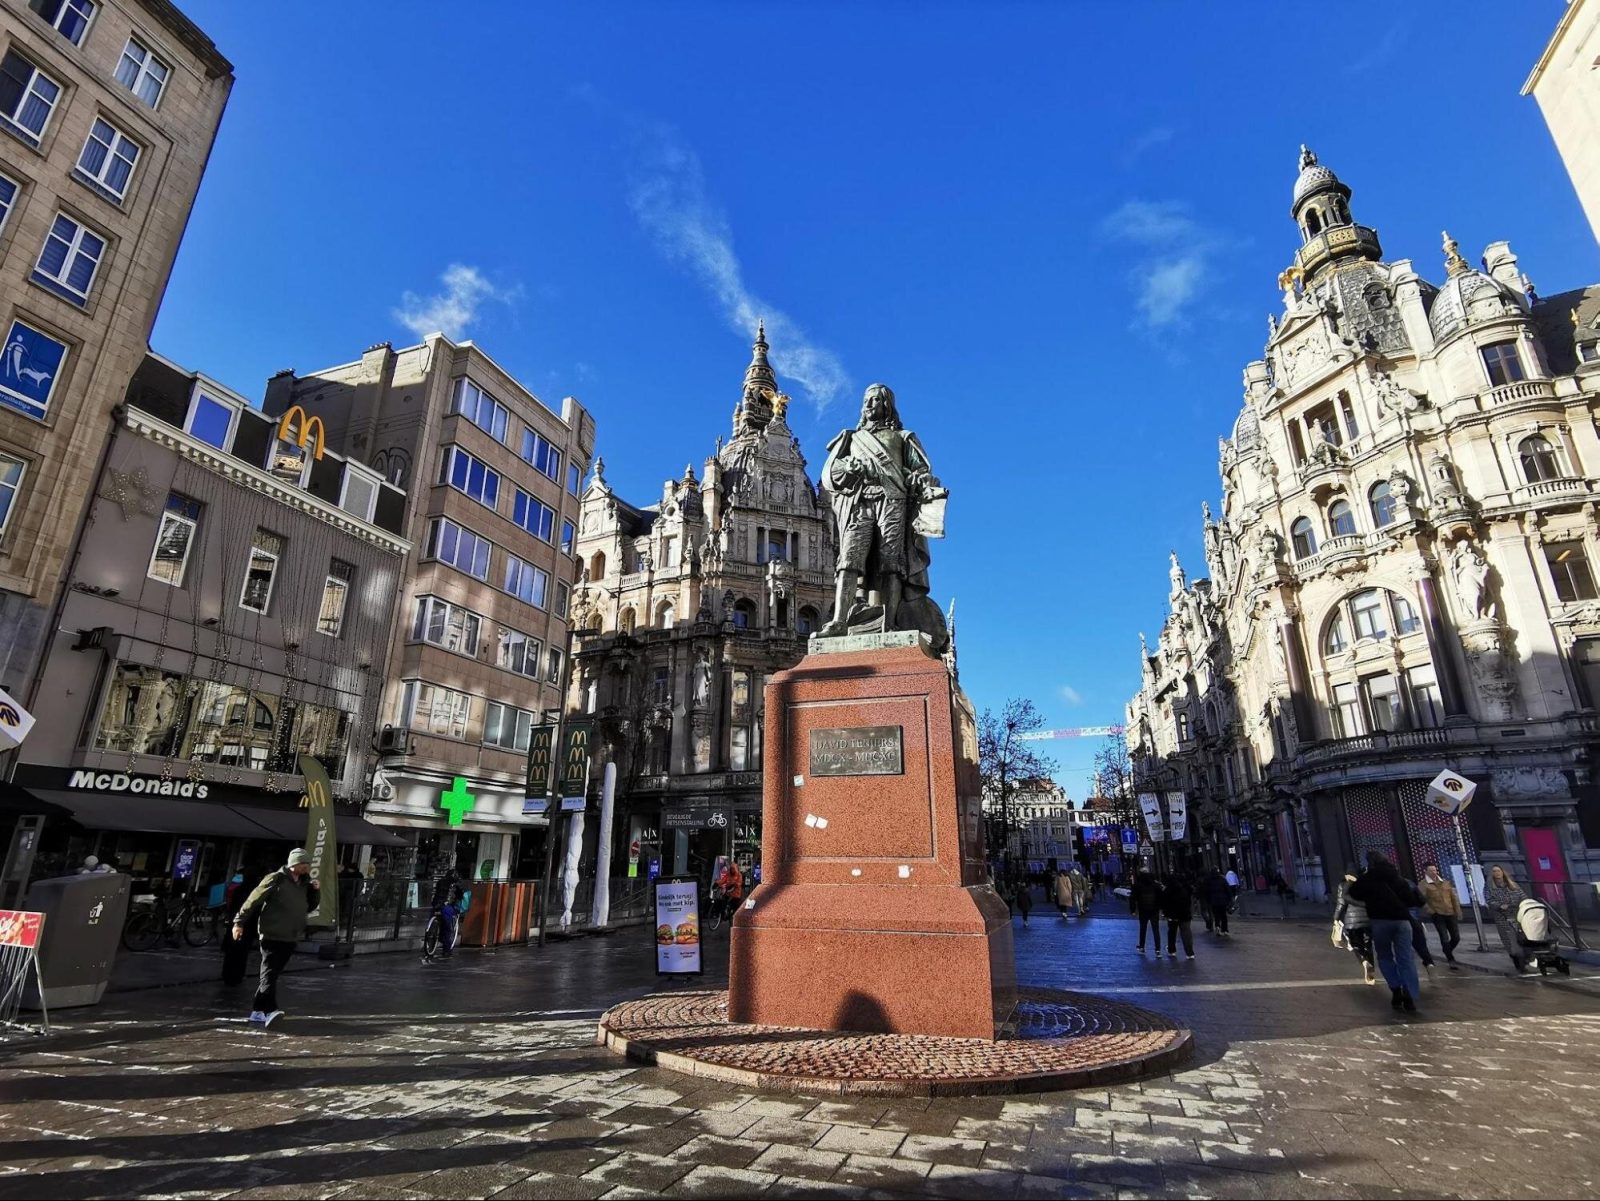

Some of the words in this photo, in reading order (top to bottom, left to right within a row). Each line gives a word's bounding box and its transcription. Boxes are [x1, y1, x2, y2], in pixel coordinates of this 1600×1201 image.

[815, 740, 848, 750] DAVID
[850, 737, 895, 749] TENIERS
[814, 754, 846, 763] MDCX
[69, 770, 209, 799] McDonald's
